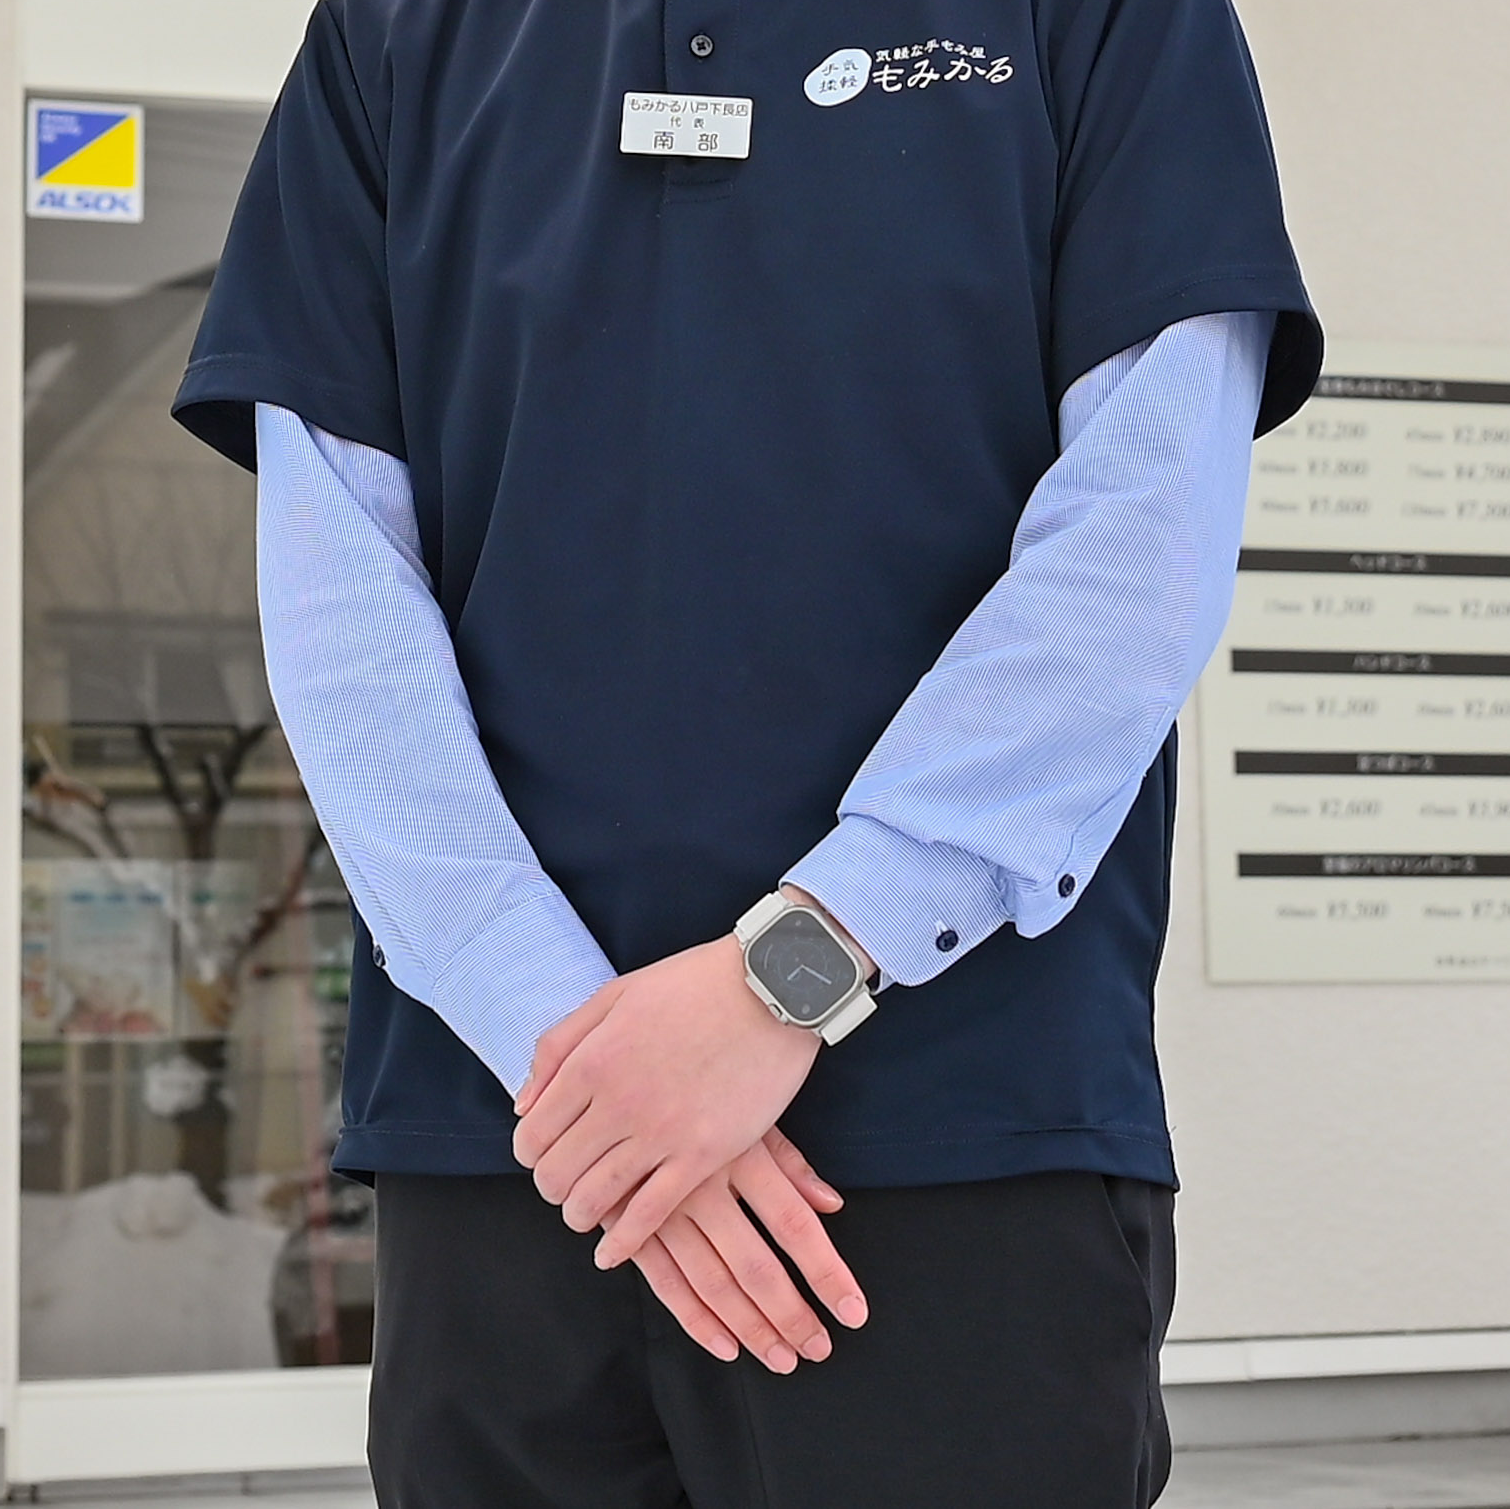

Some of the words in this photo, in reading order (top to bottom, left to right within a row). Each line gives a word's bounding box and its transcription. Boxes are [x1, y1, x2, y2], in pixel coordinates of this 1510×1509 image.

[872, 56, 1015, 93] もみかる
[630, 97, 749, 117] もみかる八戸下長店
